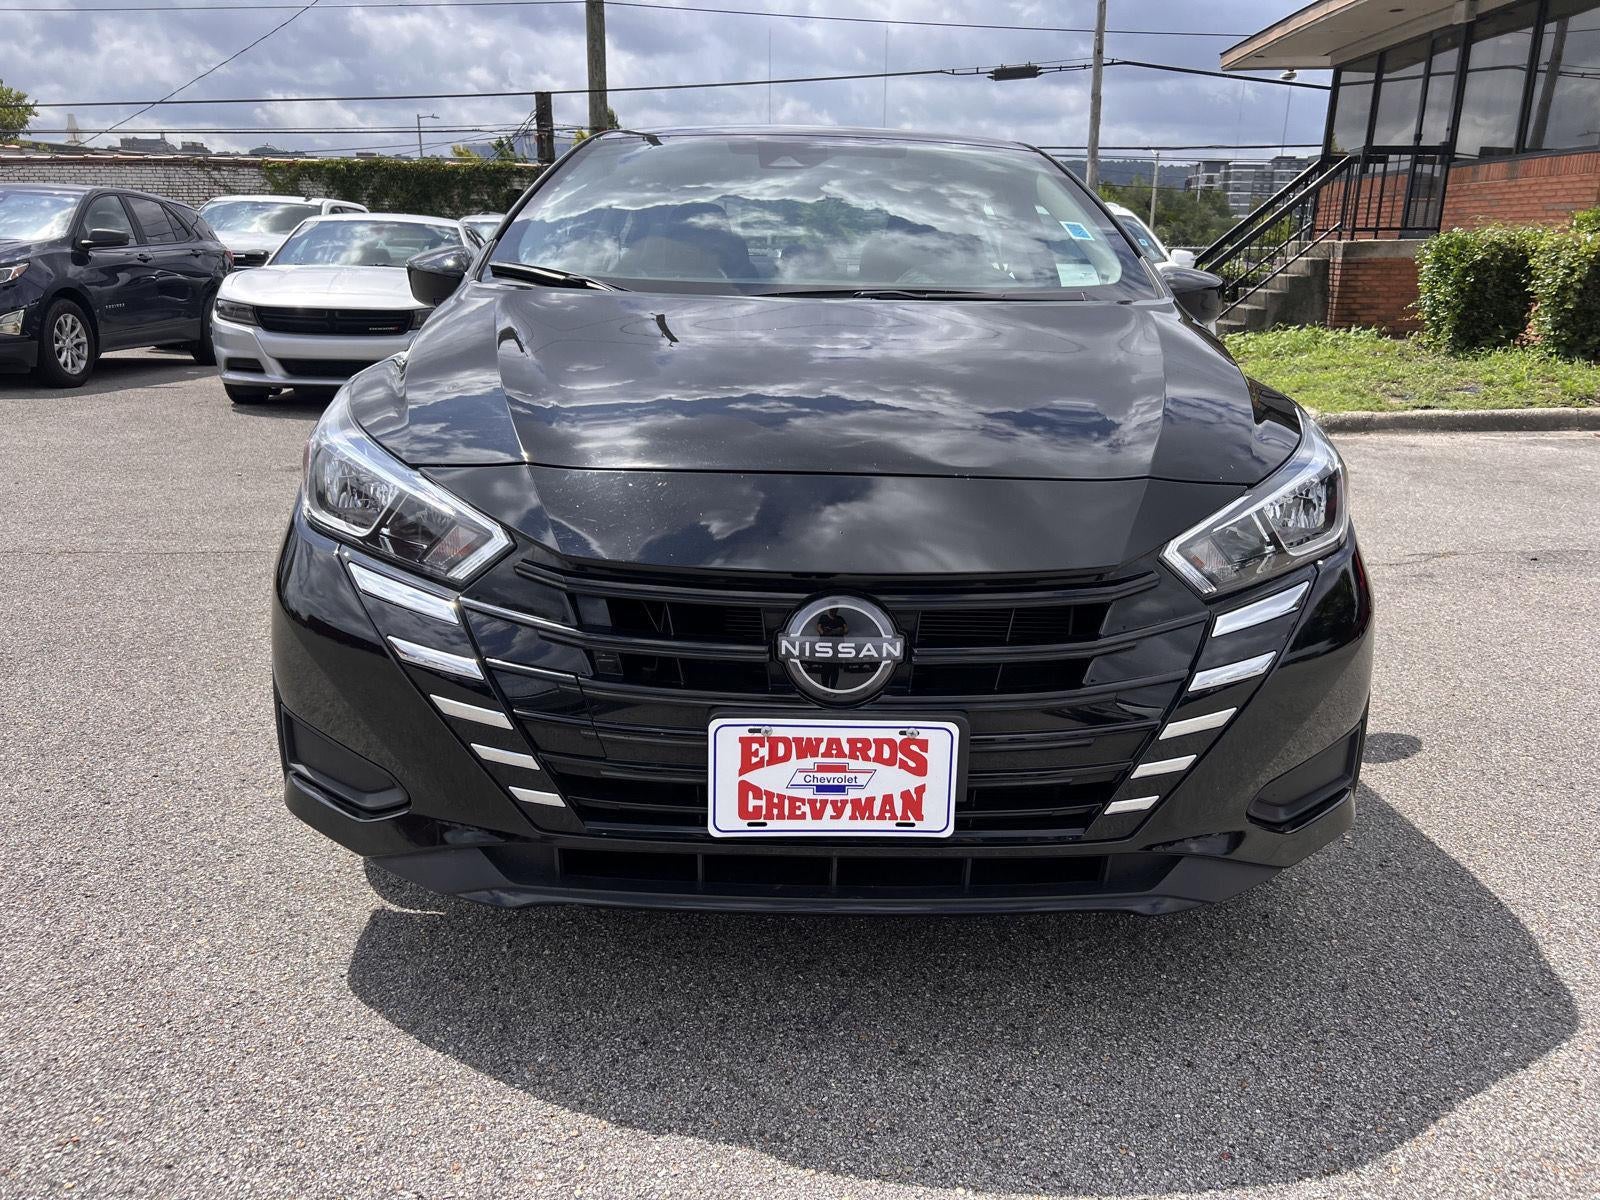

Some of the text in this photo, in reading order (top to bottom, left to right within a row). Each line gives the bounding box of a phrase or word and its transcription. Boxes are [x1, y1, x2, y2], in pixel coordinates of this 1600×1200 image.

[781, 639, 901, 658] NISSAN
[738, 736, 929, 777] EDWARDS
[803, 774, 858, 784] Chevrolet
